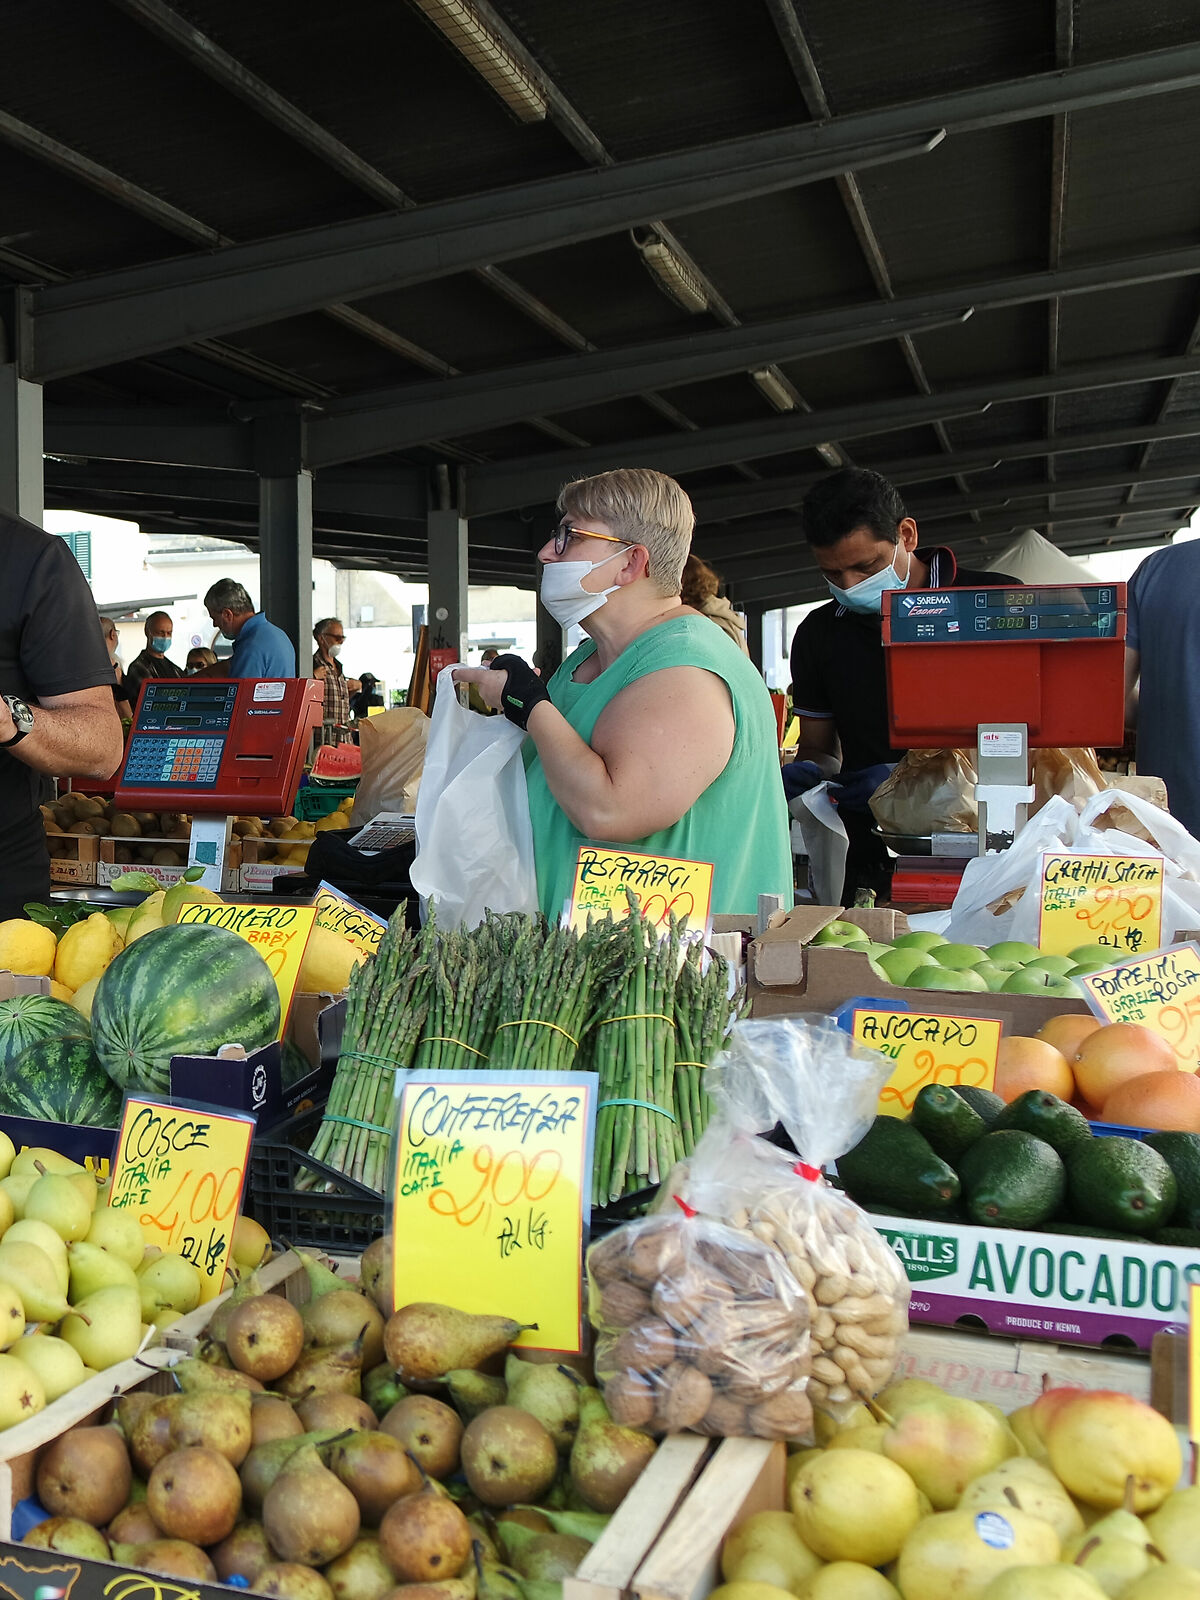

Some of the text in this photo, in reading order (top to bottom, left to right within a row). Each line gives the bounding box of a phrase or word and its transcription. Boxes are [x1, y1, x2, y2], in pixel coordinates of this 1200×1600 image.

[916, 595, 951, 605] SAREMA
[1006, 593, 1035, 606] 220
[575, 850, 699, 892] ASPARAGI
[1043, 885, 1088, 903] ITALIA
[1075, 885, 1154, 936] 2,50
[180, 904, 298, 932] COCOMERO
[247, 930, 298, 948] BABY
[1091, 955, 1176, 997] POMPELMI
[862, 1015, 978, 1047] AVOCADO
[408, 1086, 581, 1148] CONFERENZA
[125, 1107, 211, 1164] COSCE
[117, 1156, 172, 1191] ITALIA
[403, 1139, 465, 1178] ITALIA
[139, 1167, 242, 1246] 4,00
[428, 1144, 563, 1237] 2,00
[907, 1263, 930, 1274] 1890
[1006, 1315, 1081, 1335] PRODUCE OF KENYA
